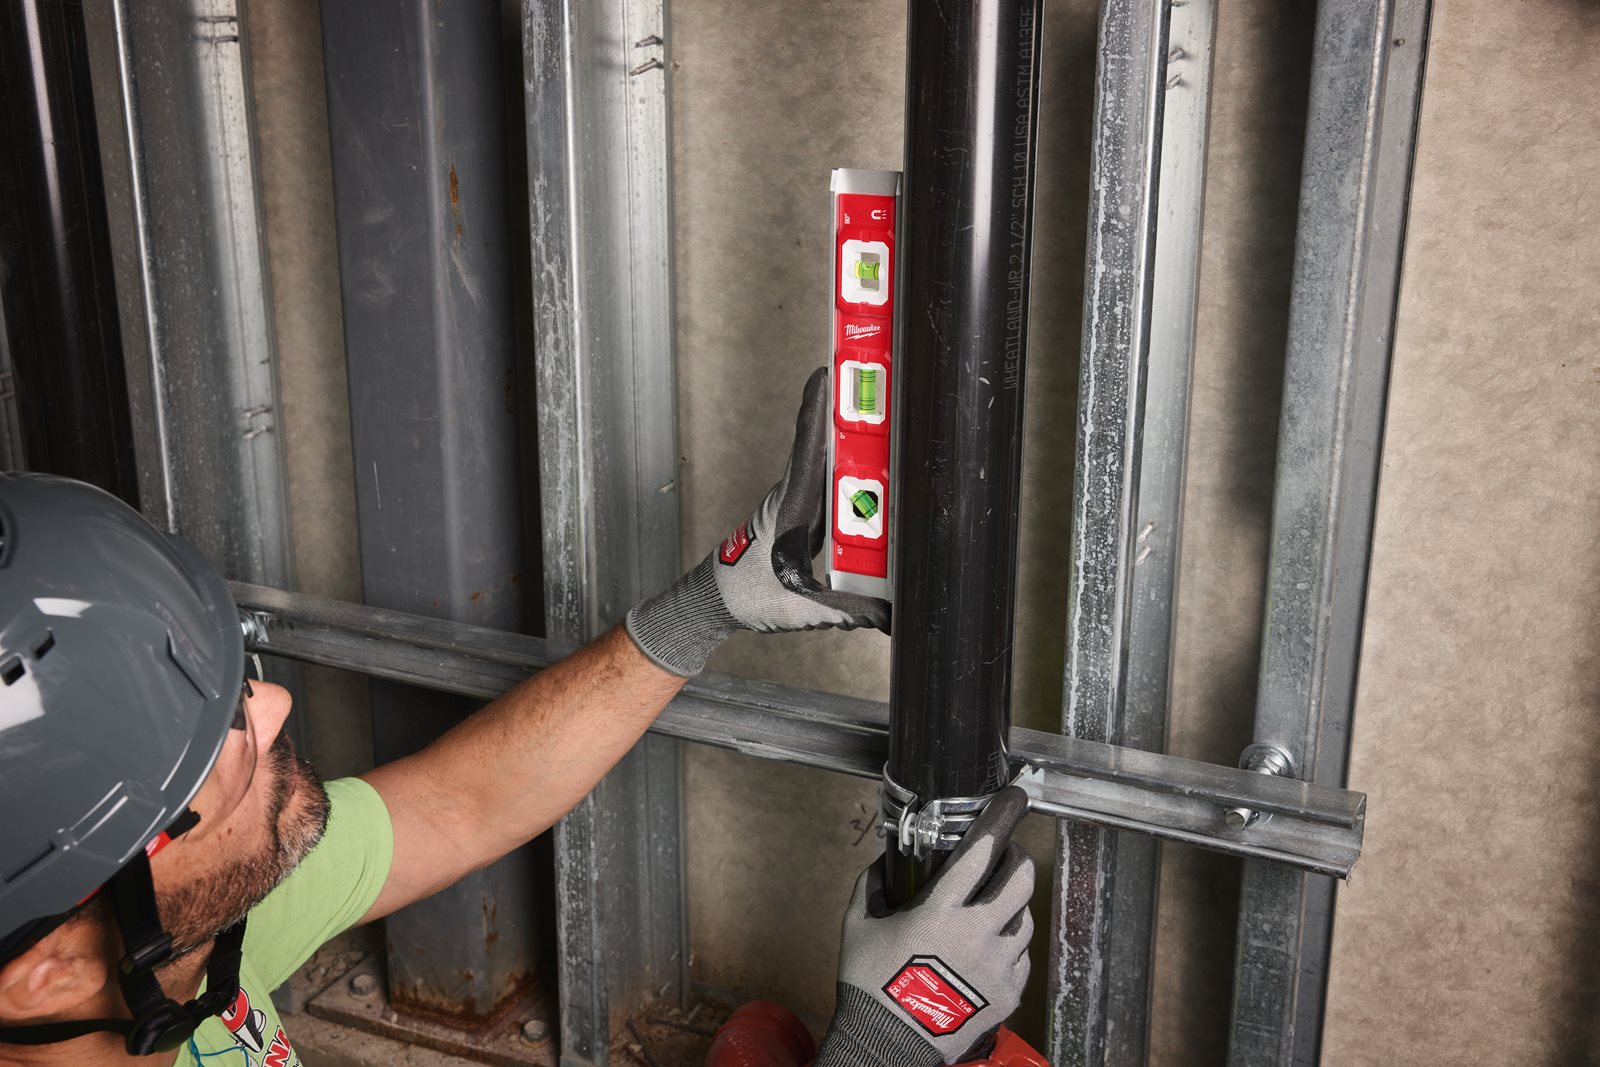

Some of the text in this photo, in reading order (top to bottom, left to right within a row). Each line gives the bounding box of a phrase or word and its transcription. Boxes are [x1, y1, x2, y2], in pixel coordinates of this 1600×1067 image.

[1016, 64, 1032, 108] ASTM
[1014, 114, 1030, 146] USA
[1012, 177, 1027, 208] SCH
[844, 323, 881, 337] Milwaukee
[903, 996, 955, 1029] Milwaukee
